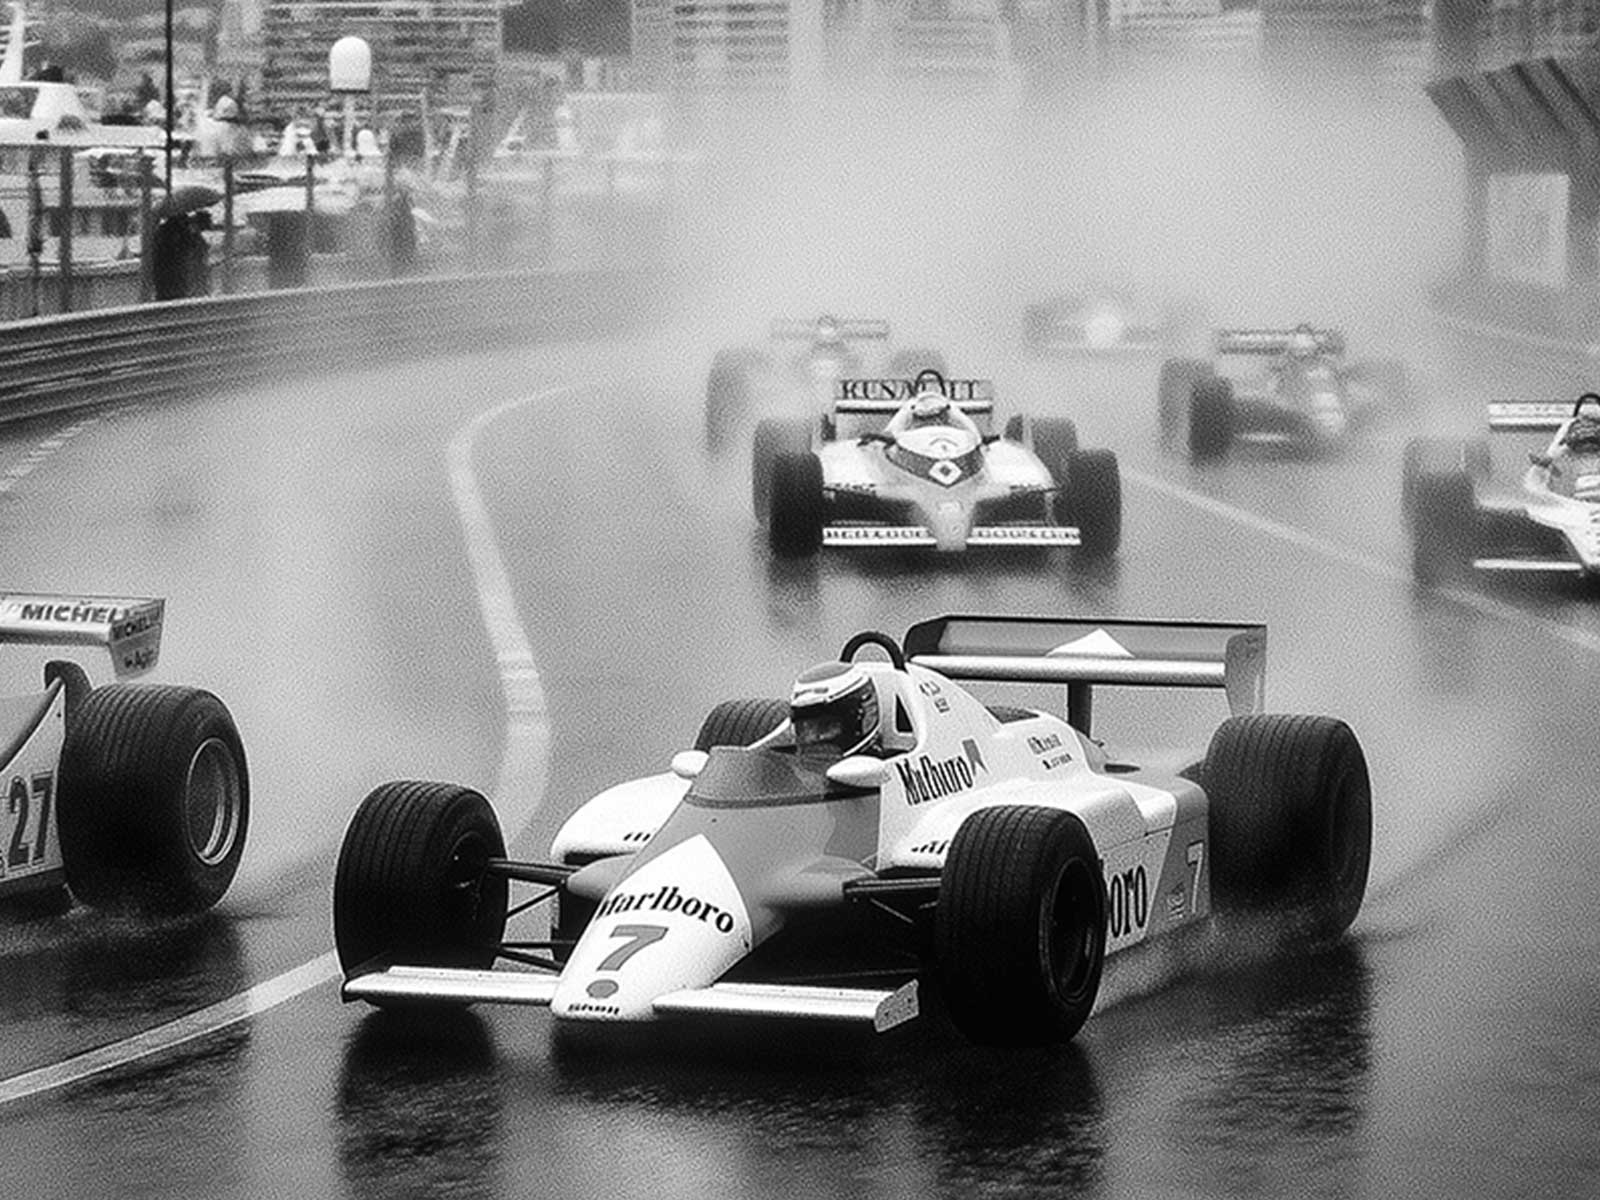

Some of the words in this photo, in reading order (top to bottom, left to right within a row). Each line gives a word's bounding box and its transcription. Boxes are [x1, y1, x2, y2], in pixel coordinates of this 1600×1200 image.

[9, 770, 54, 871] 27
[1105, 864, 1148, 938] oro
[595, 923, 670, 972] 7
